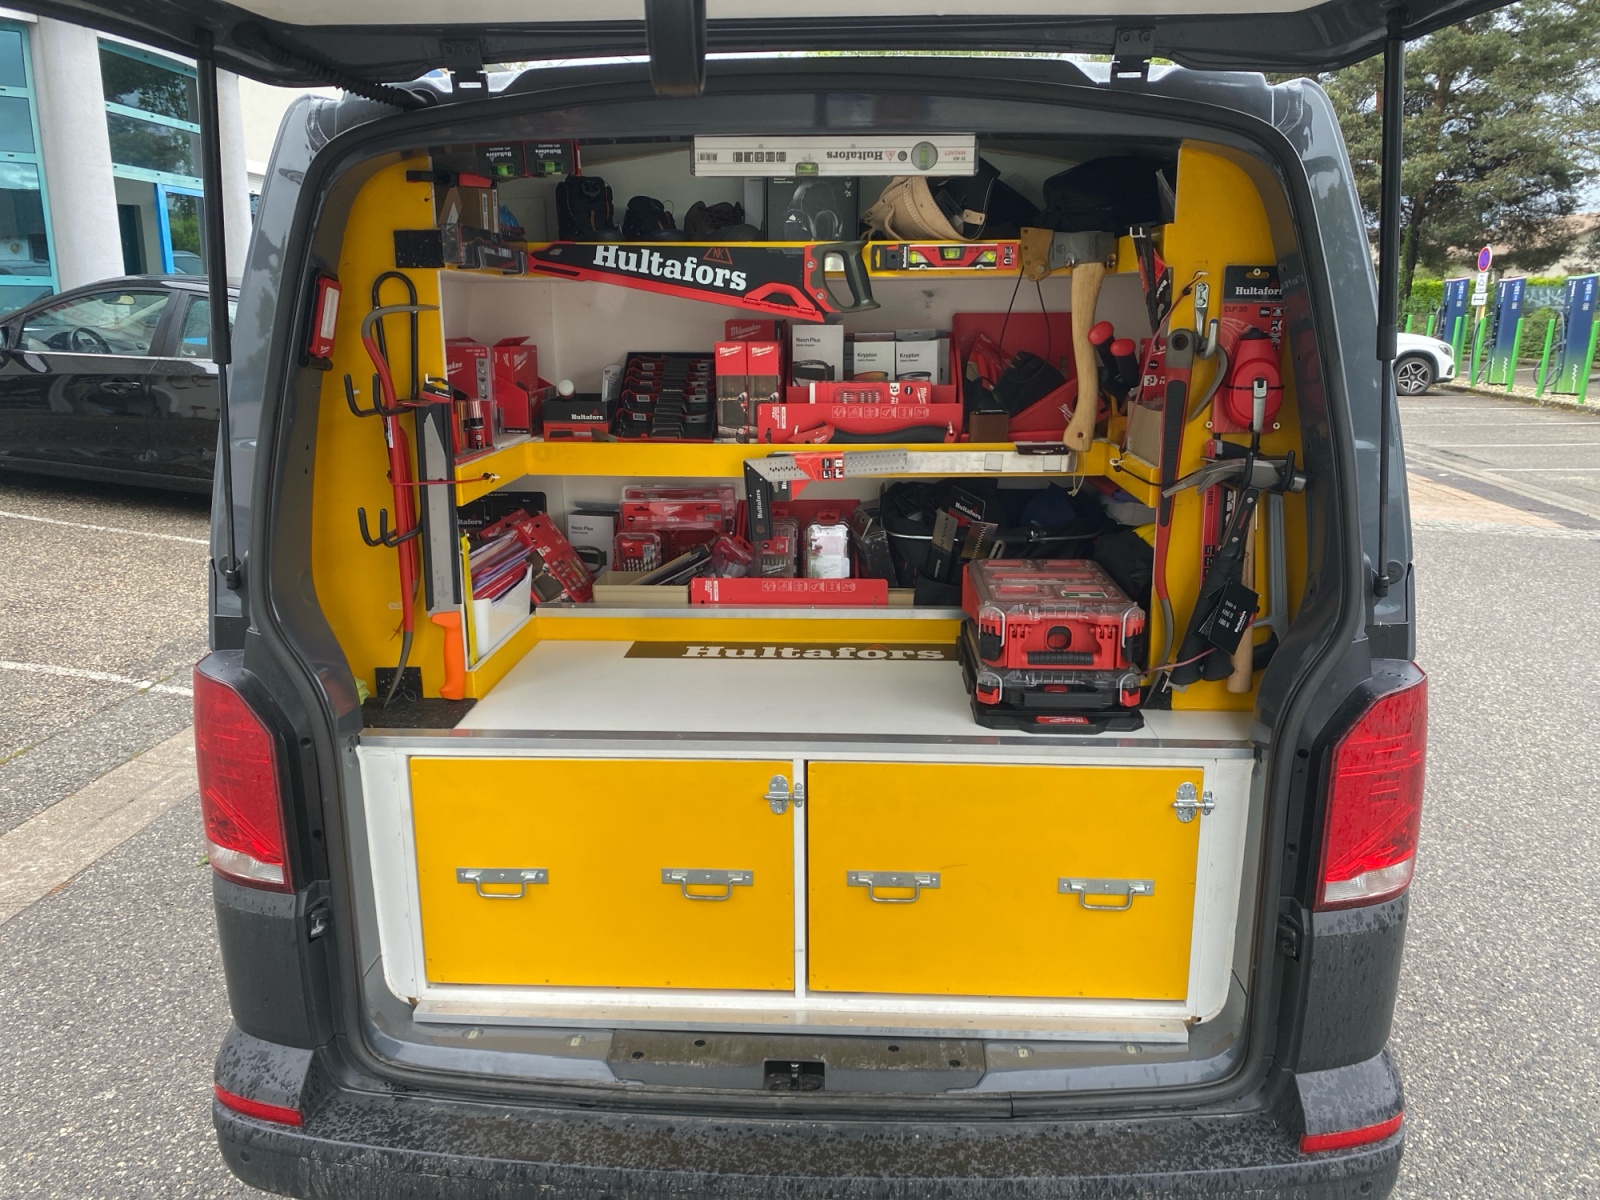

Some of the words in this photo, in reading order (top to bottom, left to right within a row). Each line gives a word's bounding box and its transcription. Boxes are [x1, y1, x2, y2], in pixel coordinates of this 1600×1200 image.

[826, 150, 883, 161] Hultafors
[593, 245, 747, 291] Hultafors
[571, 413, 604, 421] Hultafors
[755, 489, 763, 519] Hultafors
[955, 501, 982, 521] Hultafors
[457, 518, 483, 526] ltafors
[681, 646, 945, 660] Hultafors
